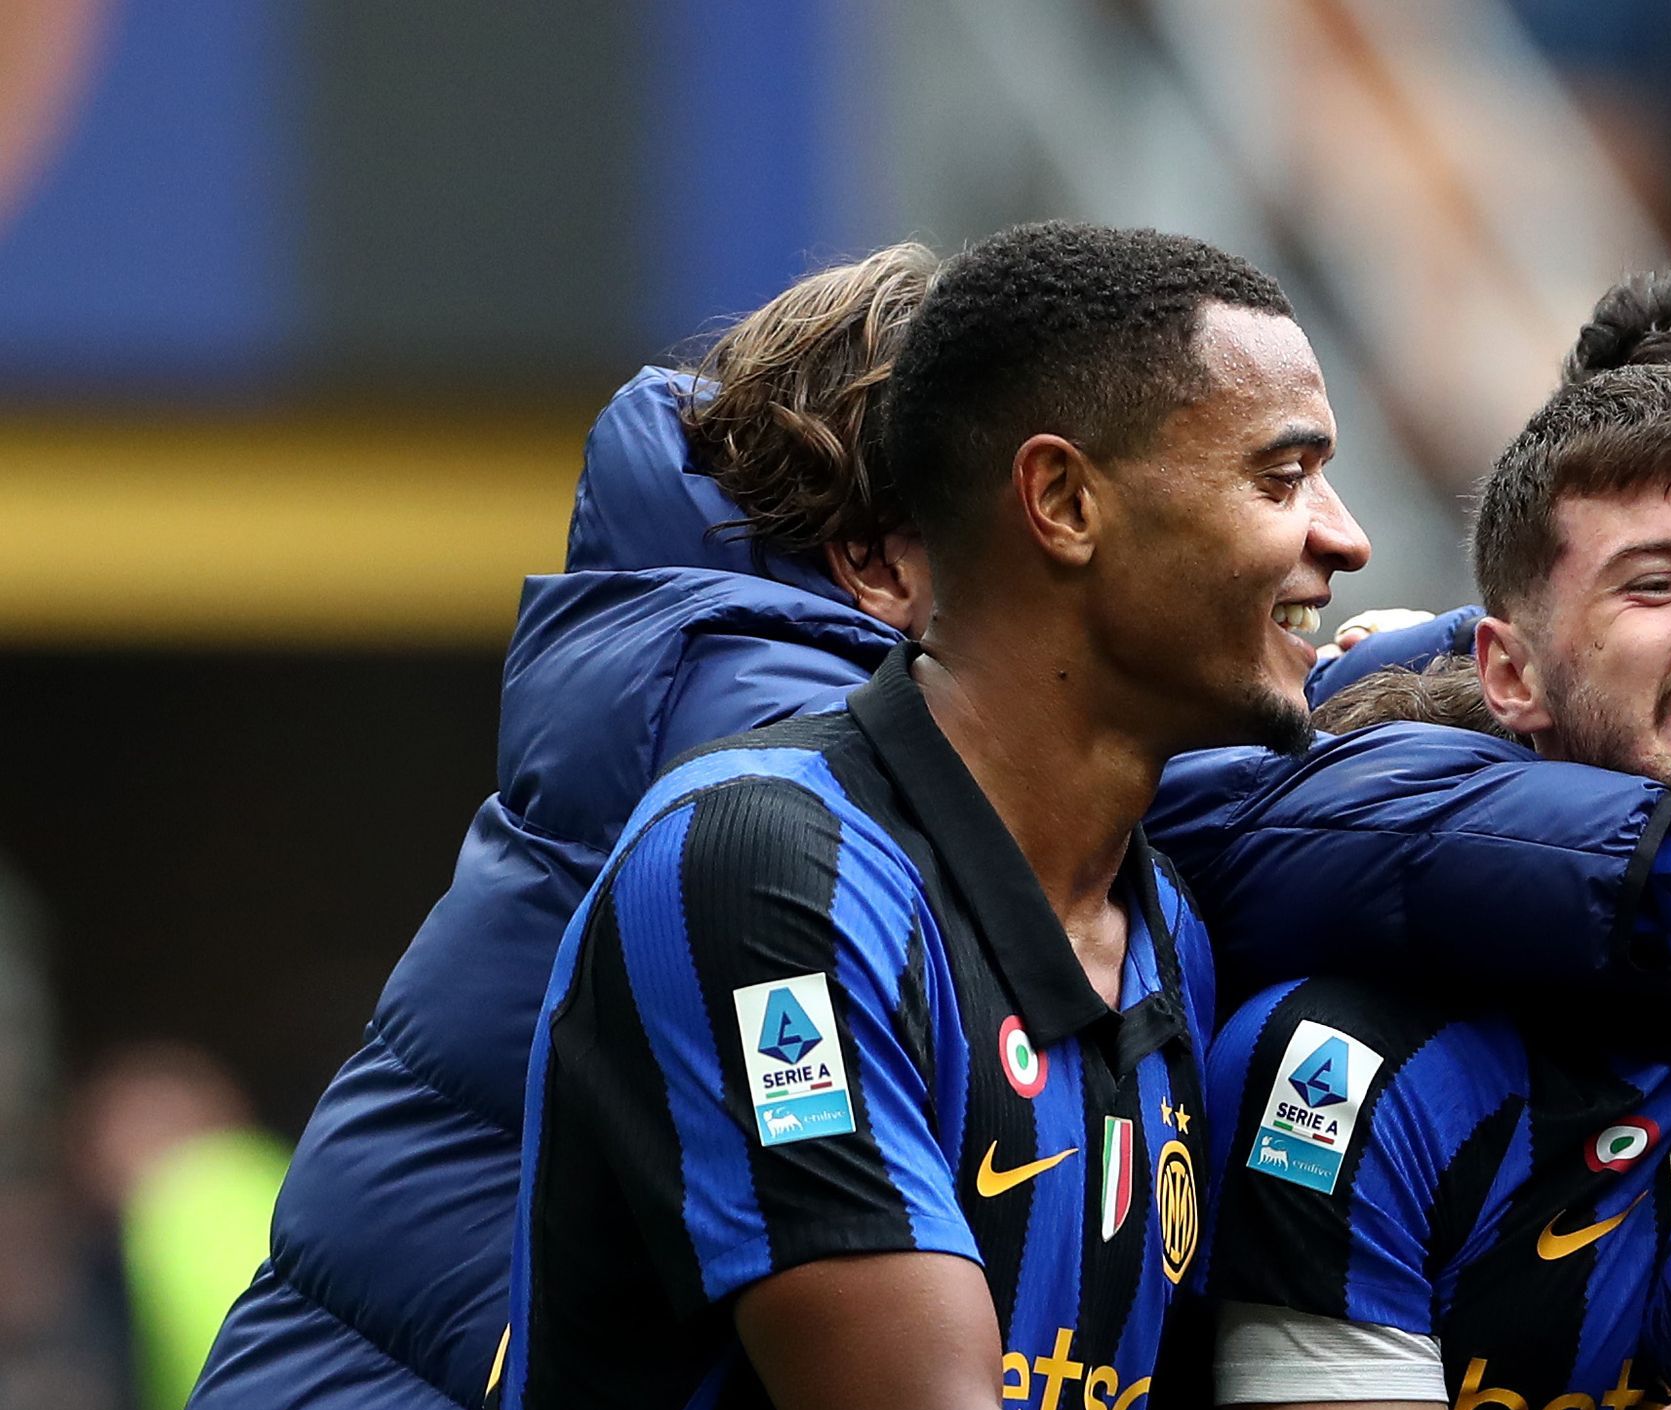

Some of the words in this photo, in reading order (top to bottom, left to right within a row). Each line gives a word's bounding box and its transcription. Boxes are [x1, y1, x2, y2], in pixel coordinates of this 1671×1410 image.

[763, 1065, 814, 1089] SERIE
[818, 1063, 831, 1079] A
[1276, 1102, 1325, 1130] SERIE
[1325, 1120, 1338, 1136] A
[1292, 1159, 1332, 1178] enilive
